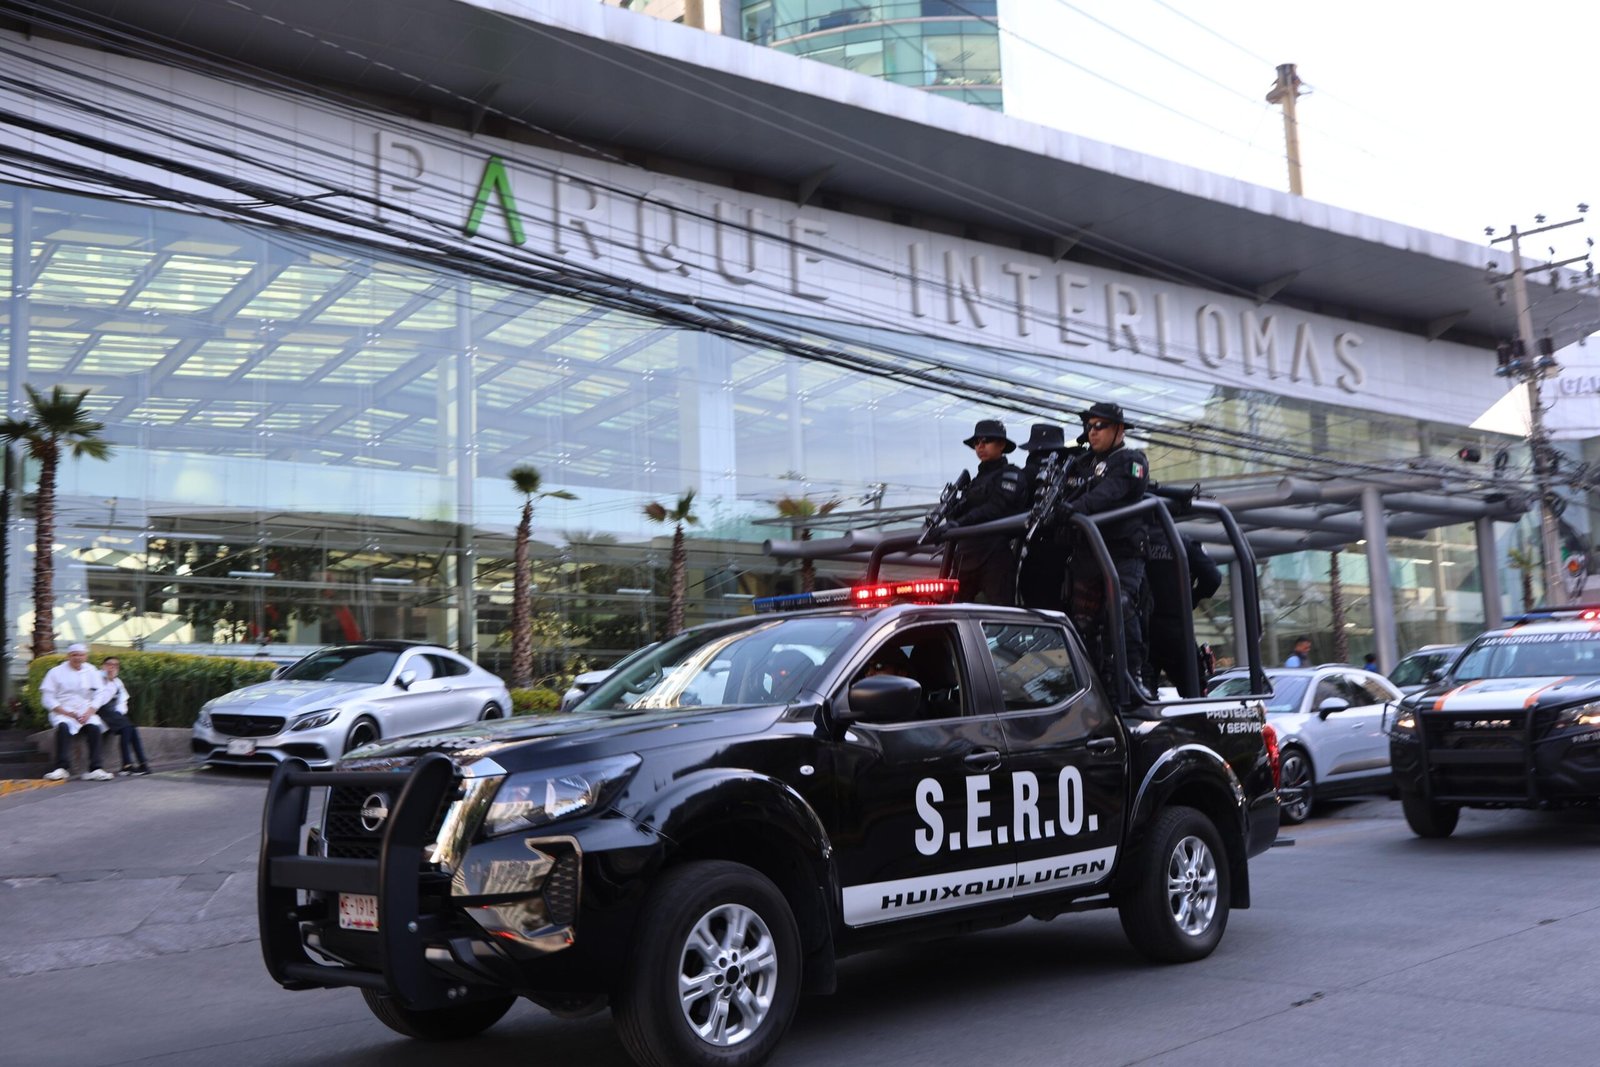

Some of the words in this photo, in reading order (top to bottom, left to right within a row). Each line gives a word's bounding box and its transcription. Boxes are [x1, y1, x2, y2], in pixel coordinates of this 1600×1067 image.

[374, 130, 829, 301] PARQUE
[908, 242, 1365, 394] INTERLOMAS
[1152, 551, 1174, 560] CIAL
[1218, 722, 1225, 734] Y
[1227, 721, 1262, 734] SERVIR
[914, 765, 1099, 856] S.E.R.O.
[881, 859, 1107, 910] HUIXQUILUCAN
